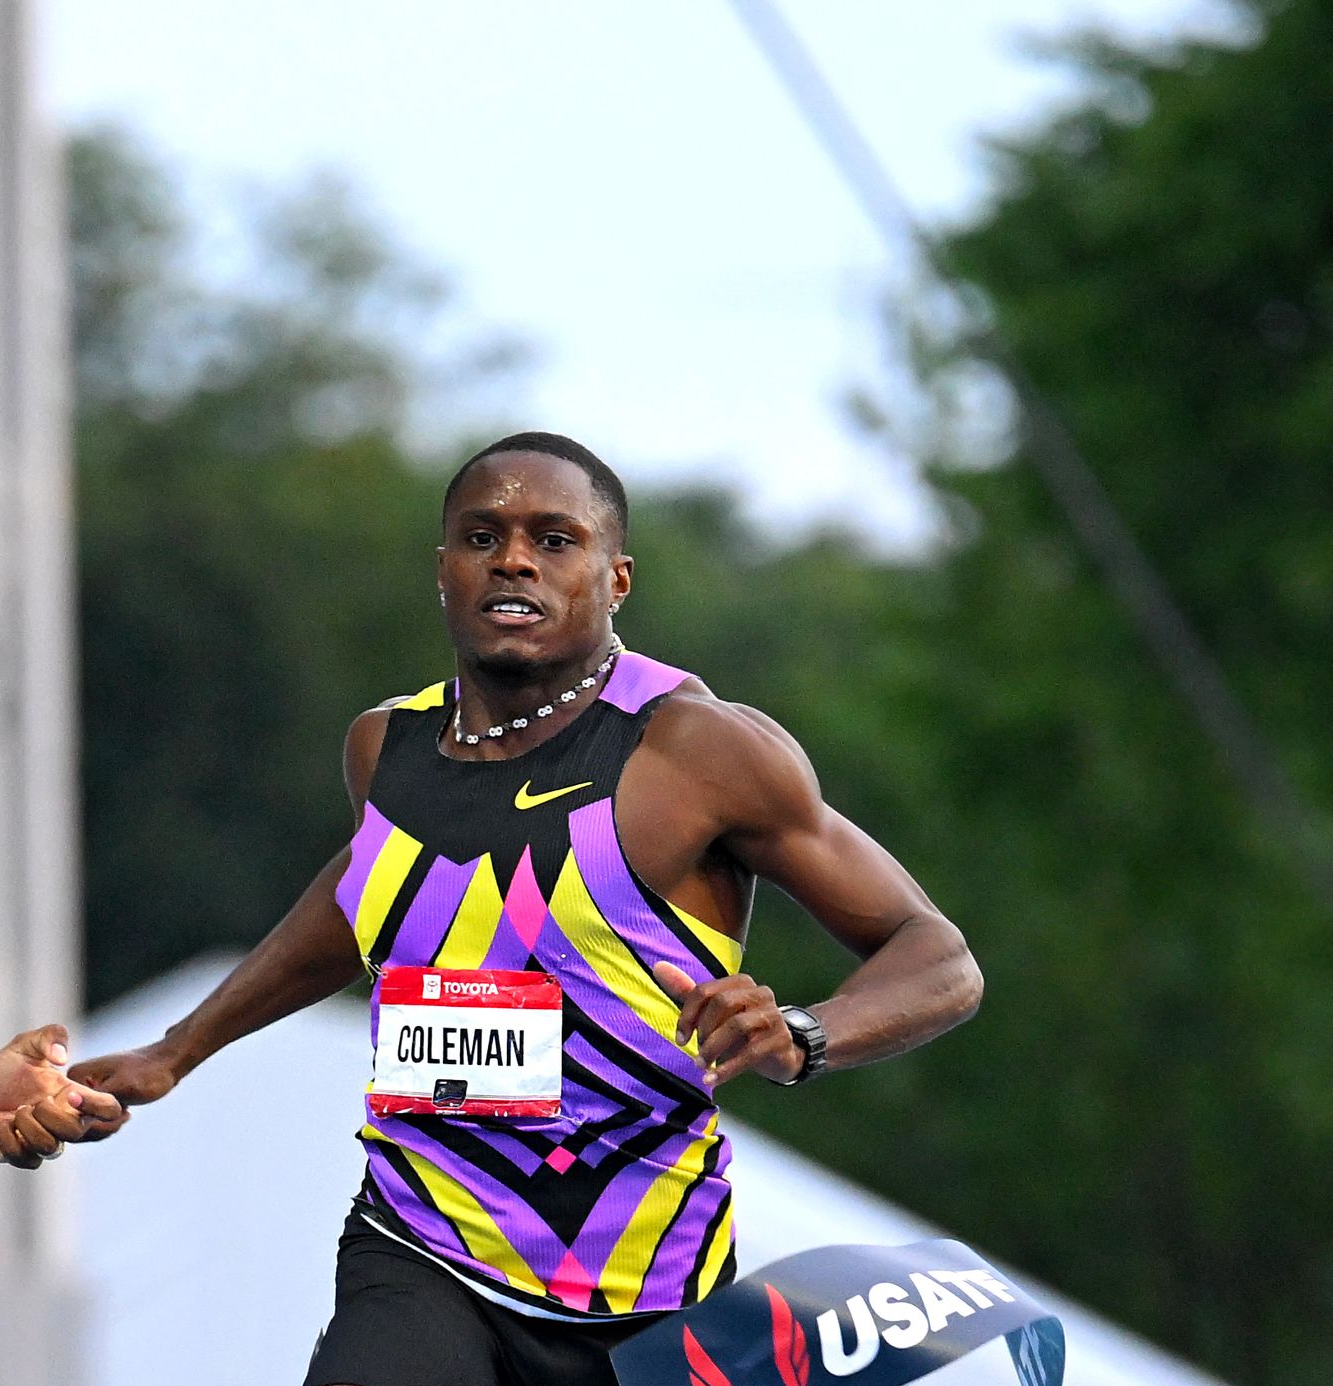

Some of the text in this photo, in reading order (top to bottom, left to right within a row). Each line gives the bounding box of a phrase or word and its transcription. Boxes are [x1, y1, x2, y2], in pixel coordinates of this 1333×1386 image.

[443, 981, 499, 995] TOYOTA
[397, 1025, 525, 1067] COLEMAN
[816, 1269, 1016, 1377] USATF
